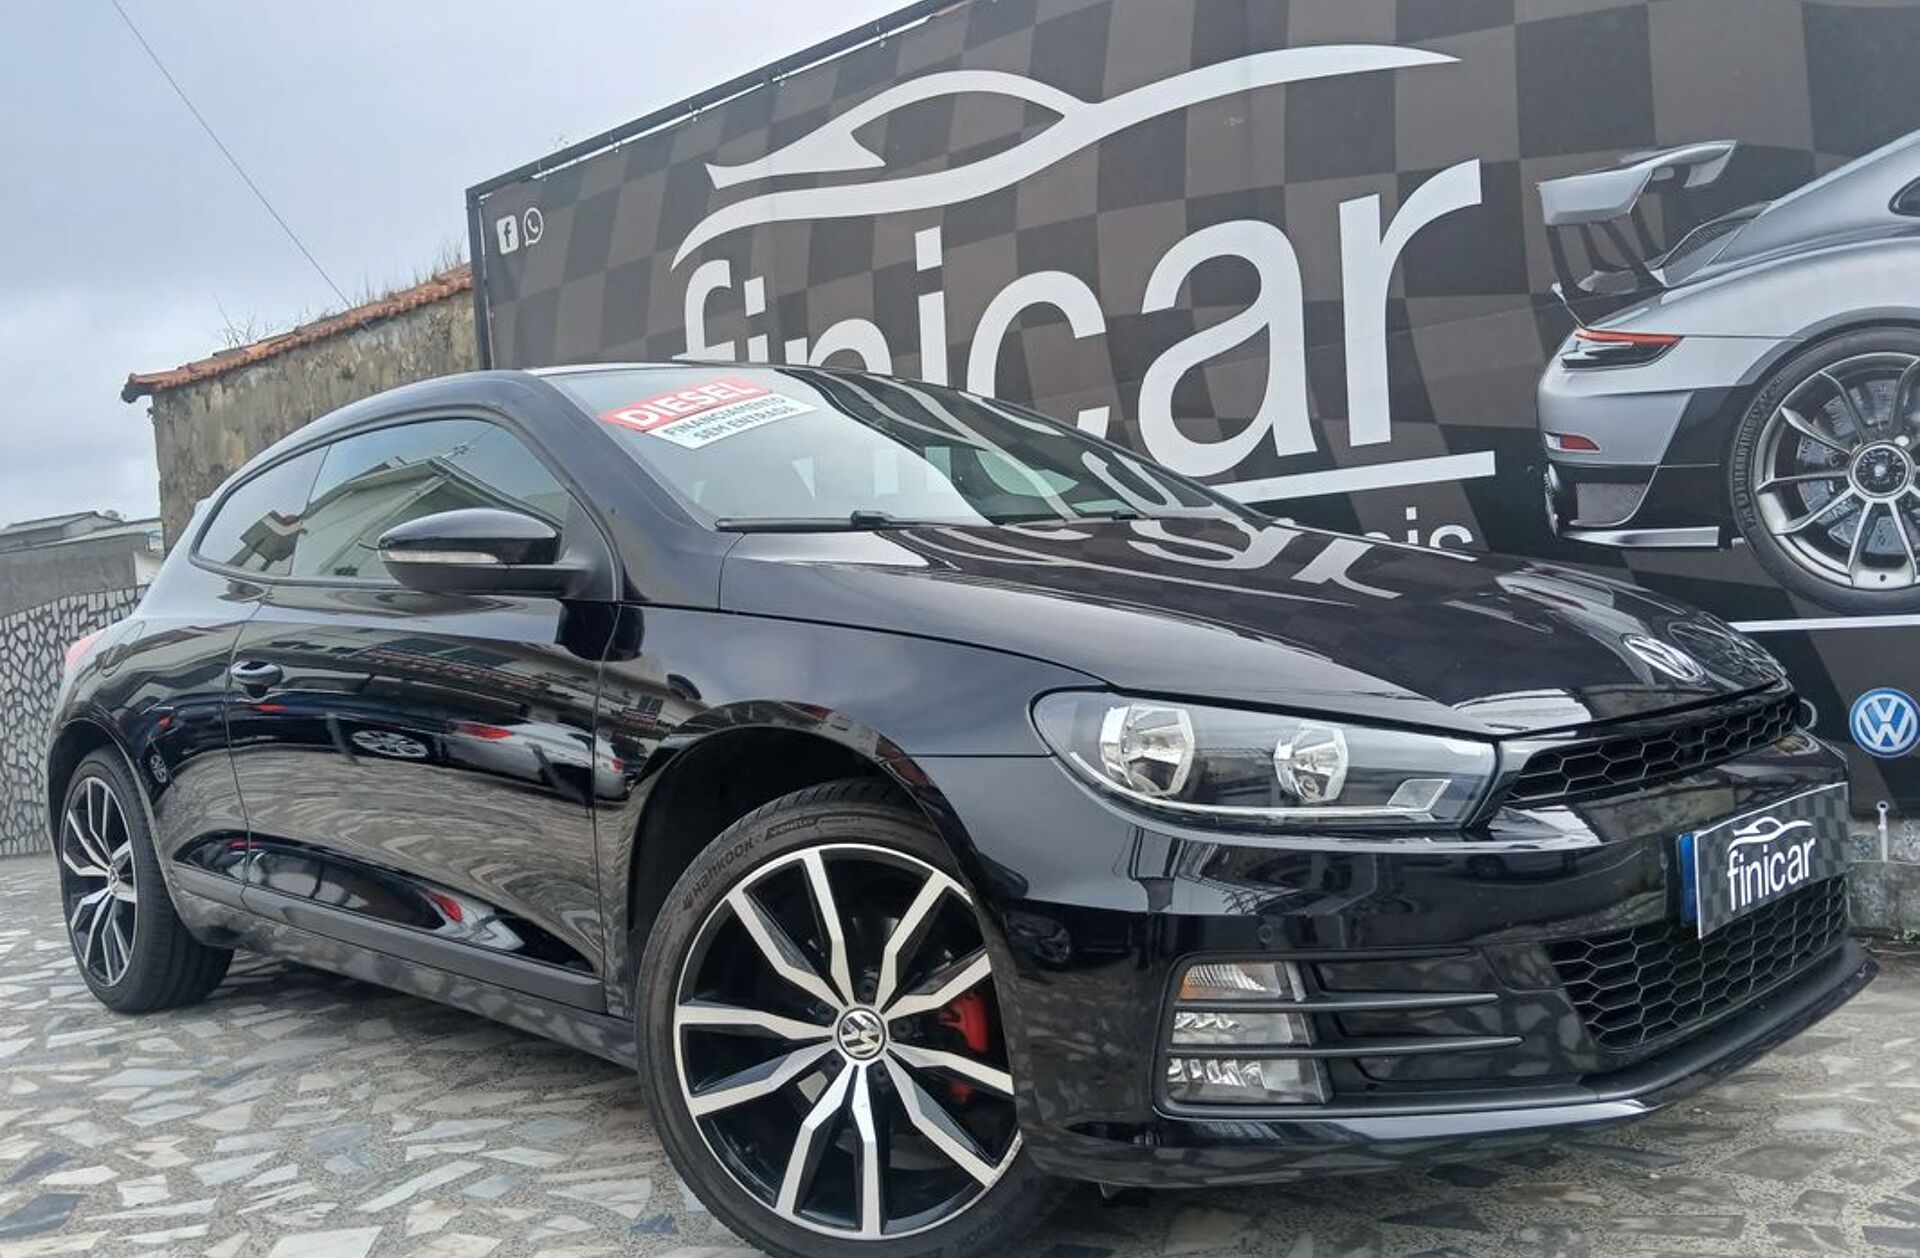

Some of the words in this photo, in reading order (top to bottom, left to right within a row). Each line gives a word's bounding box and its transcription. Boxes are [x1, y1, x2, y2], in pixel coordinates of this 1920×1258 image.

[615, 381, 759, 427] DIESEL
[661, 395, 786, 436] FINANCIAMENTO
[692, 420, 729, 440] SEM
[728, 405, 799, 430] ENTRADA
[1727, 837, 1817, 912] finicar
